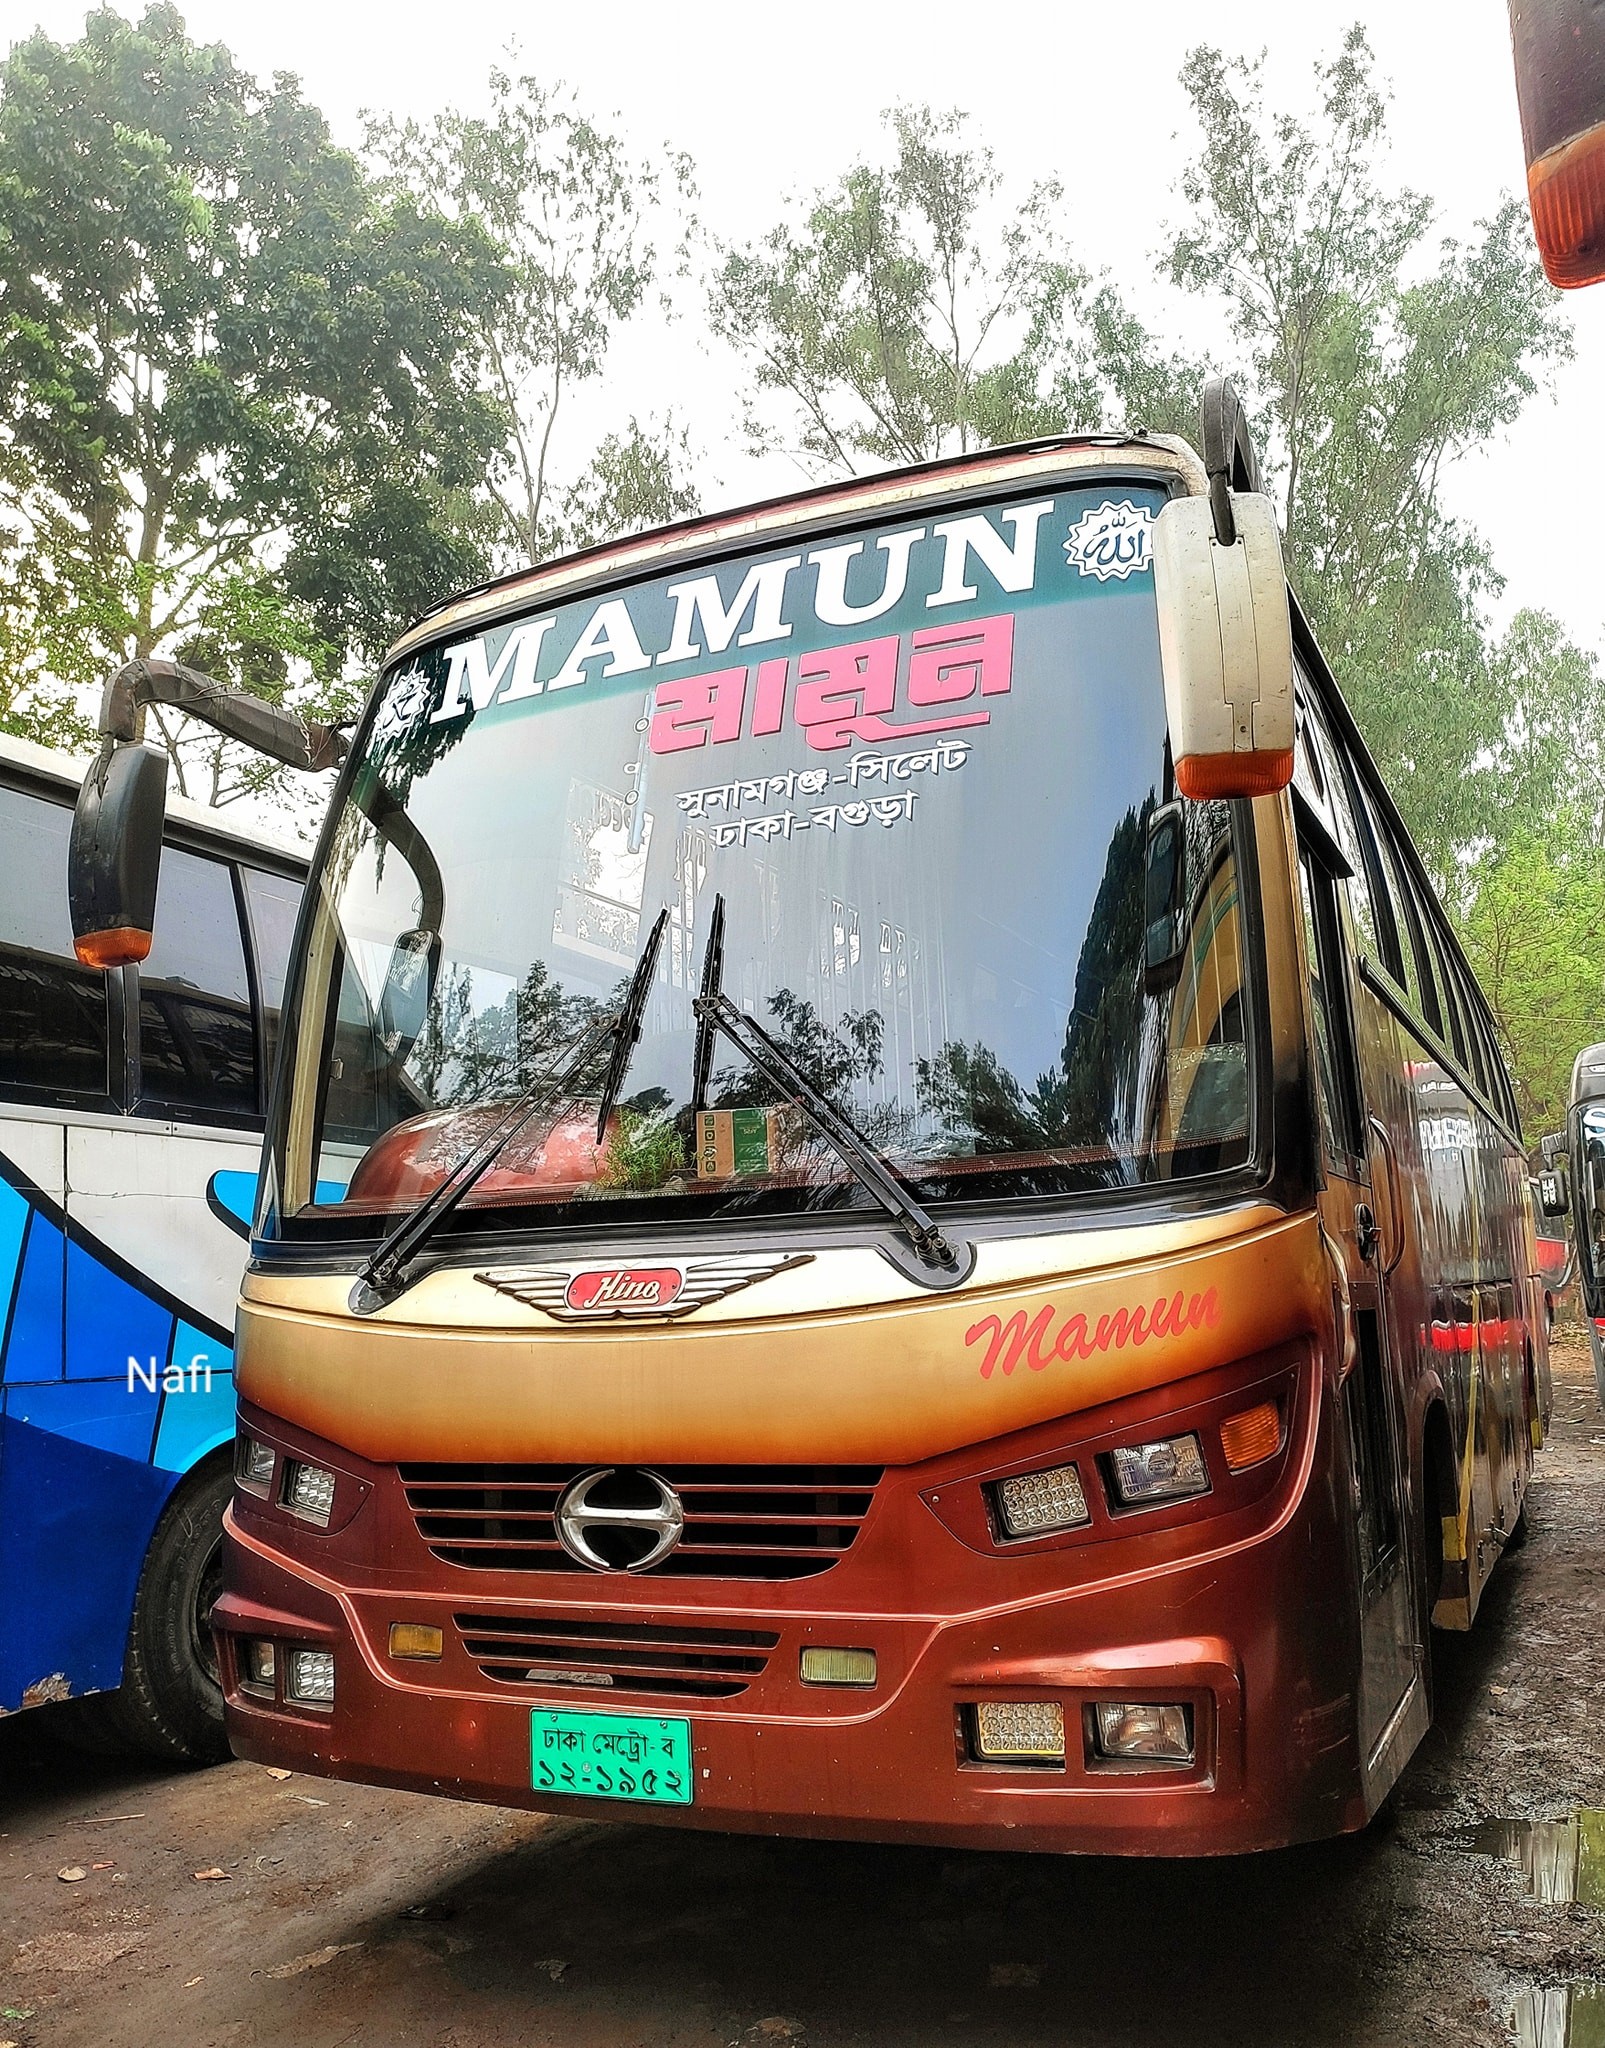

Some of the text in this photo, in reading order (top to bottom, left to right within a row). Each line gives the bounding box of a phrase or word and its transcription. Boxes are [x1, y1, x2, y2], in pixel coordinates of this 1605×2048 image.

[429, 500, 1054, 724] MAMUN
[583, 1271, 660, 1308] Hino
[965, 1286, 1220, 1380] Mamun
[542, 1728, 586, 1753] ঢাকা
[538, 1760, 684, 1798] ১২-১৯৫২
